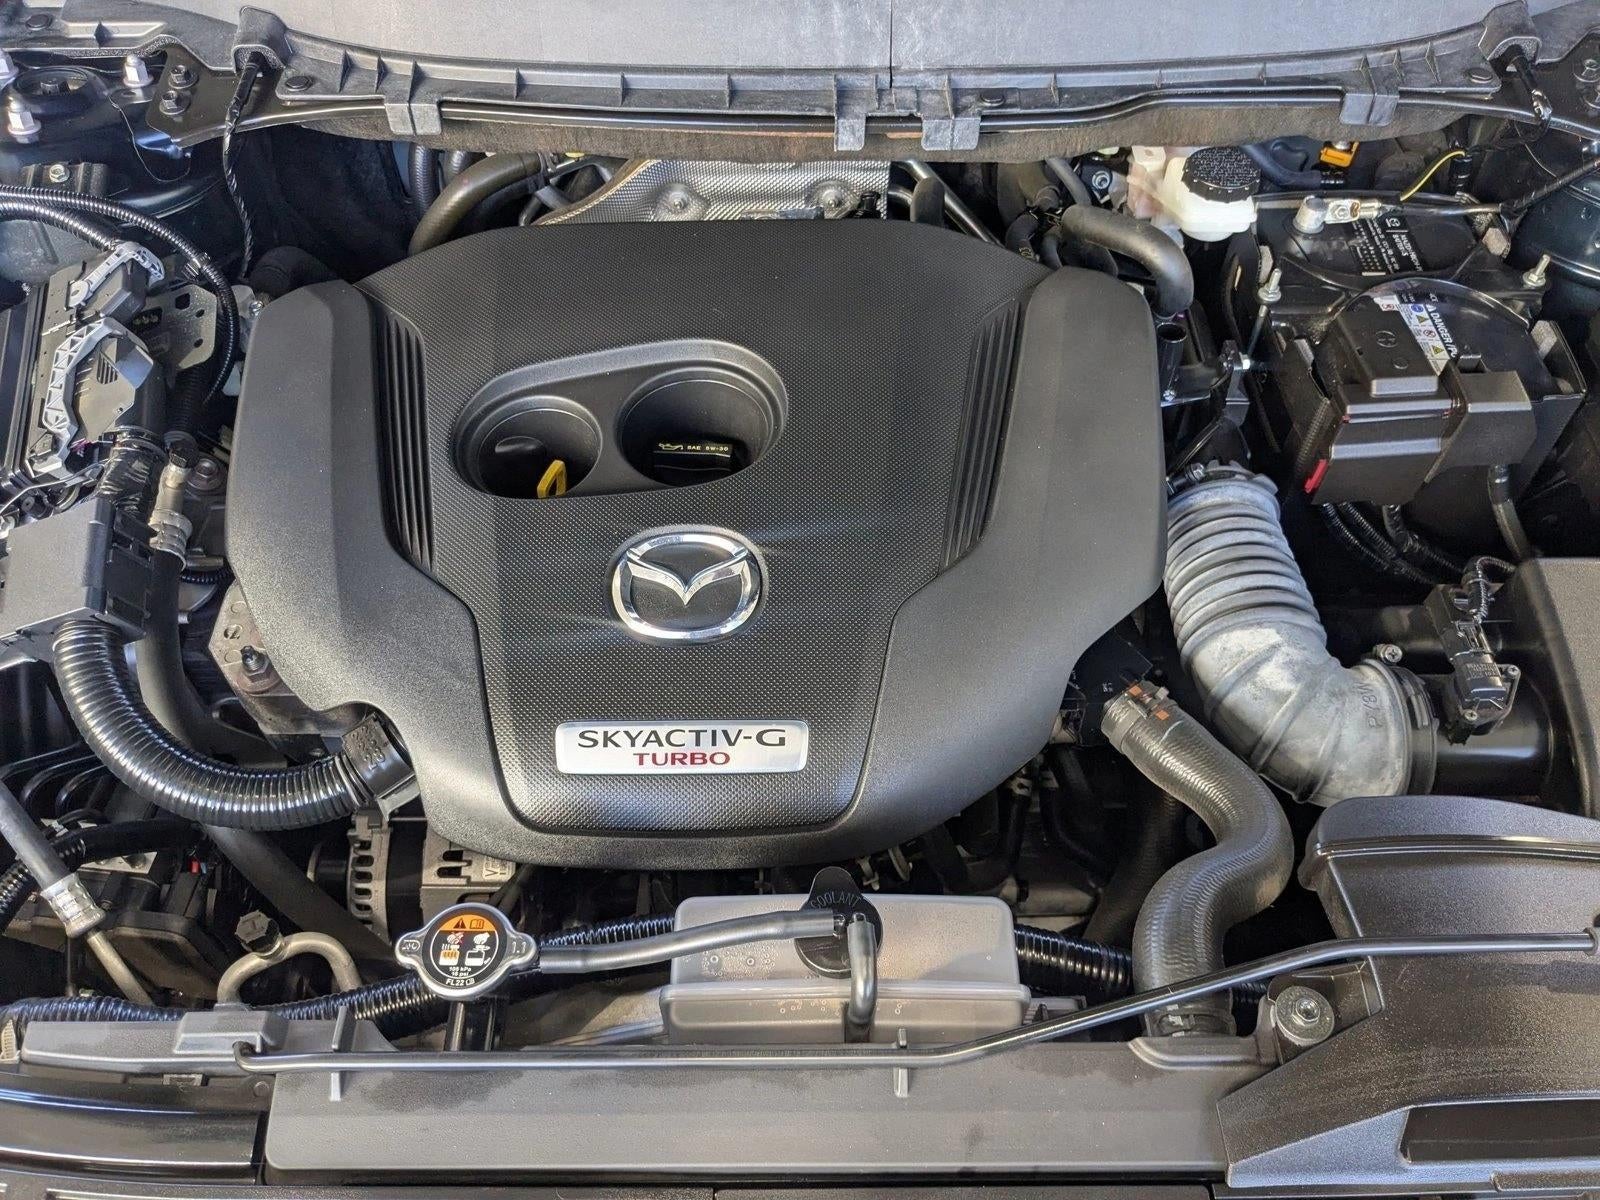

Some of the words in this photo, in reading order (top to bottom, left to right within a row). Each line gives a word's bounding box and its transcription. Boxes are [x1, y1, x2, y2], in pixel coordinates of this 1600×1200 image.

[577, 728, 786, 748] SKYACTIV-G
[633, 752, 731, 766] TURBO
[811, 890, 862, 908] COOLANT
[445, 977, 465, 986] FL22
